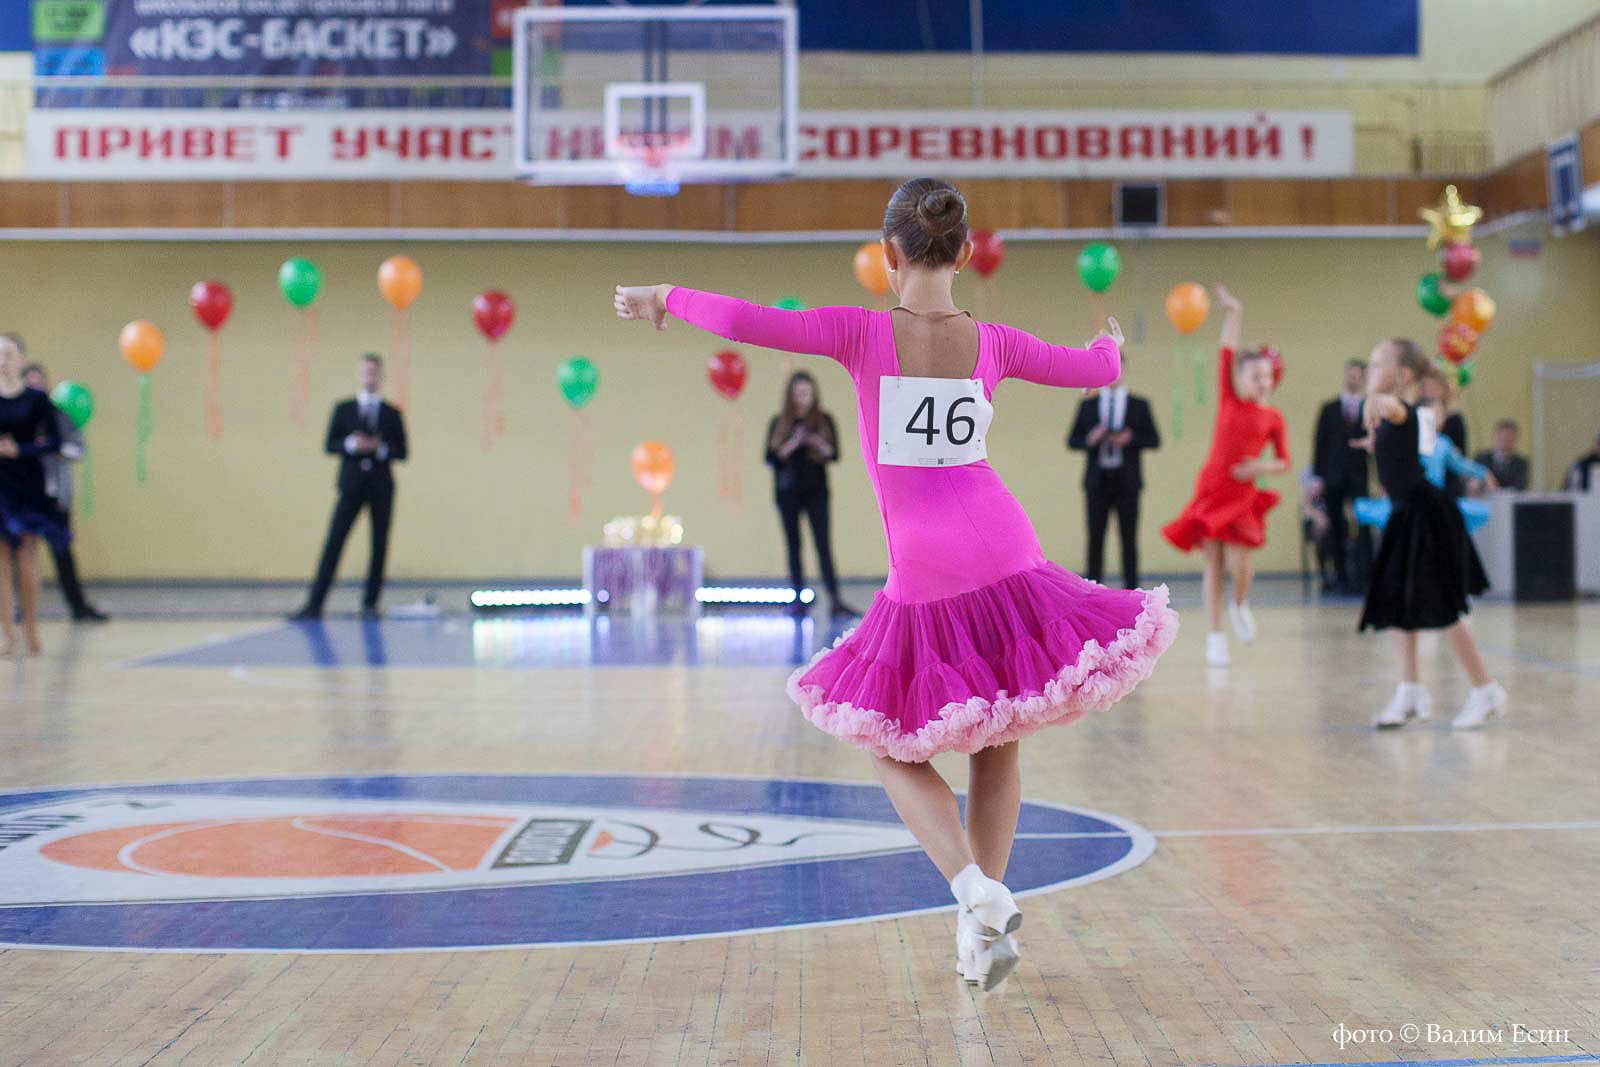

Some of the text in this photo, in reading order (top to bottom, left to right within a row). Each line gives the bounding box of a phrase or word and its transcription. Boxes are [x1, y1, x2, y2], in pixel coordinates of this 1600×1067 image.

[129, 18, 457, 60] «КЭС-БАСКЕТ»
[54, 126, 303, 160] ПРИВЕТ
[797, 112, 1282, 160] СОРЕВНОВАНИЙ
[1301, 126, 1315, 160] !
[905, 396, 976, 446] 46
